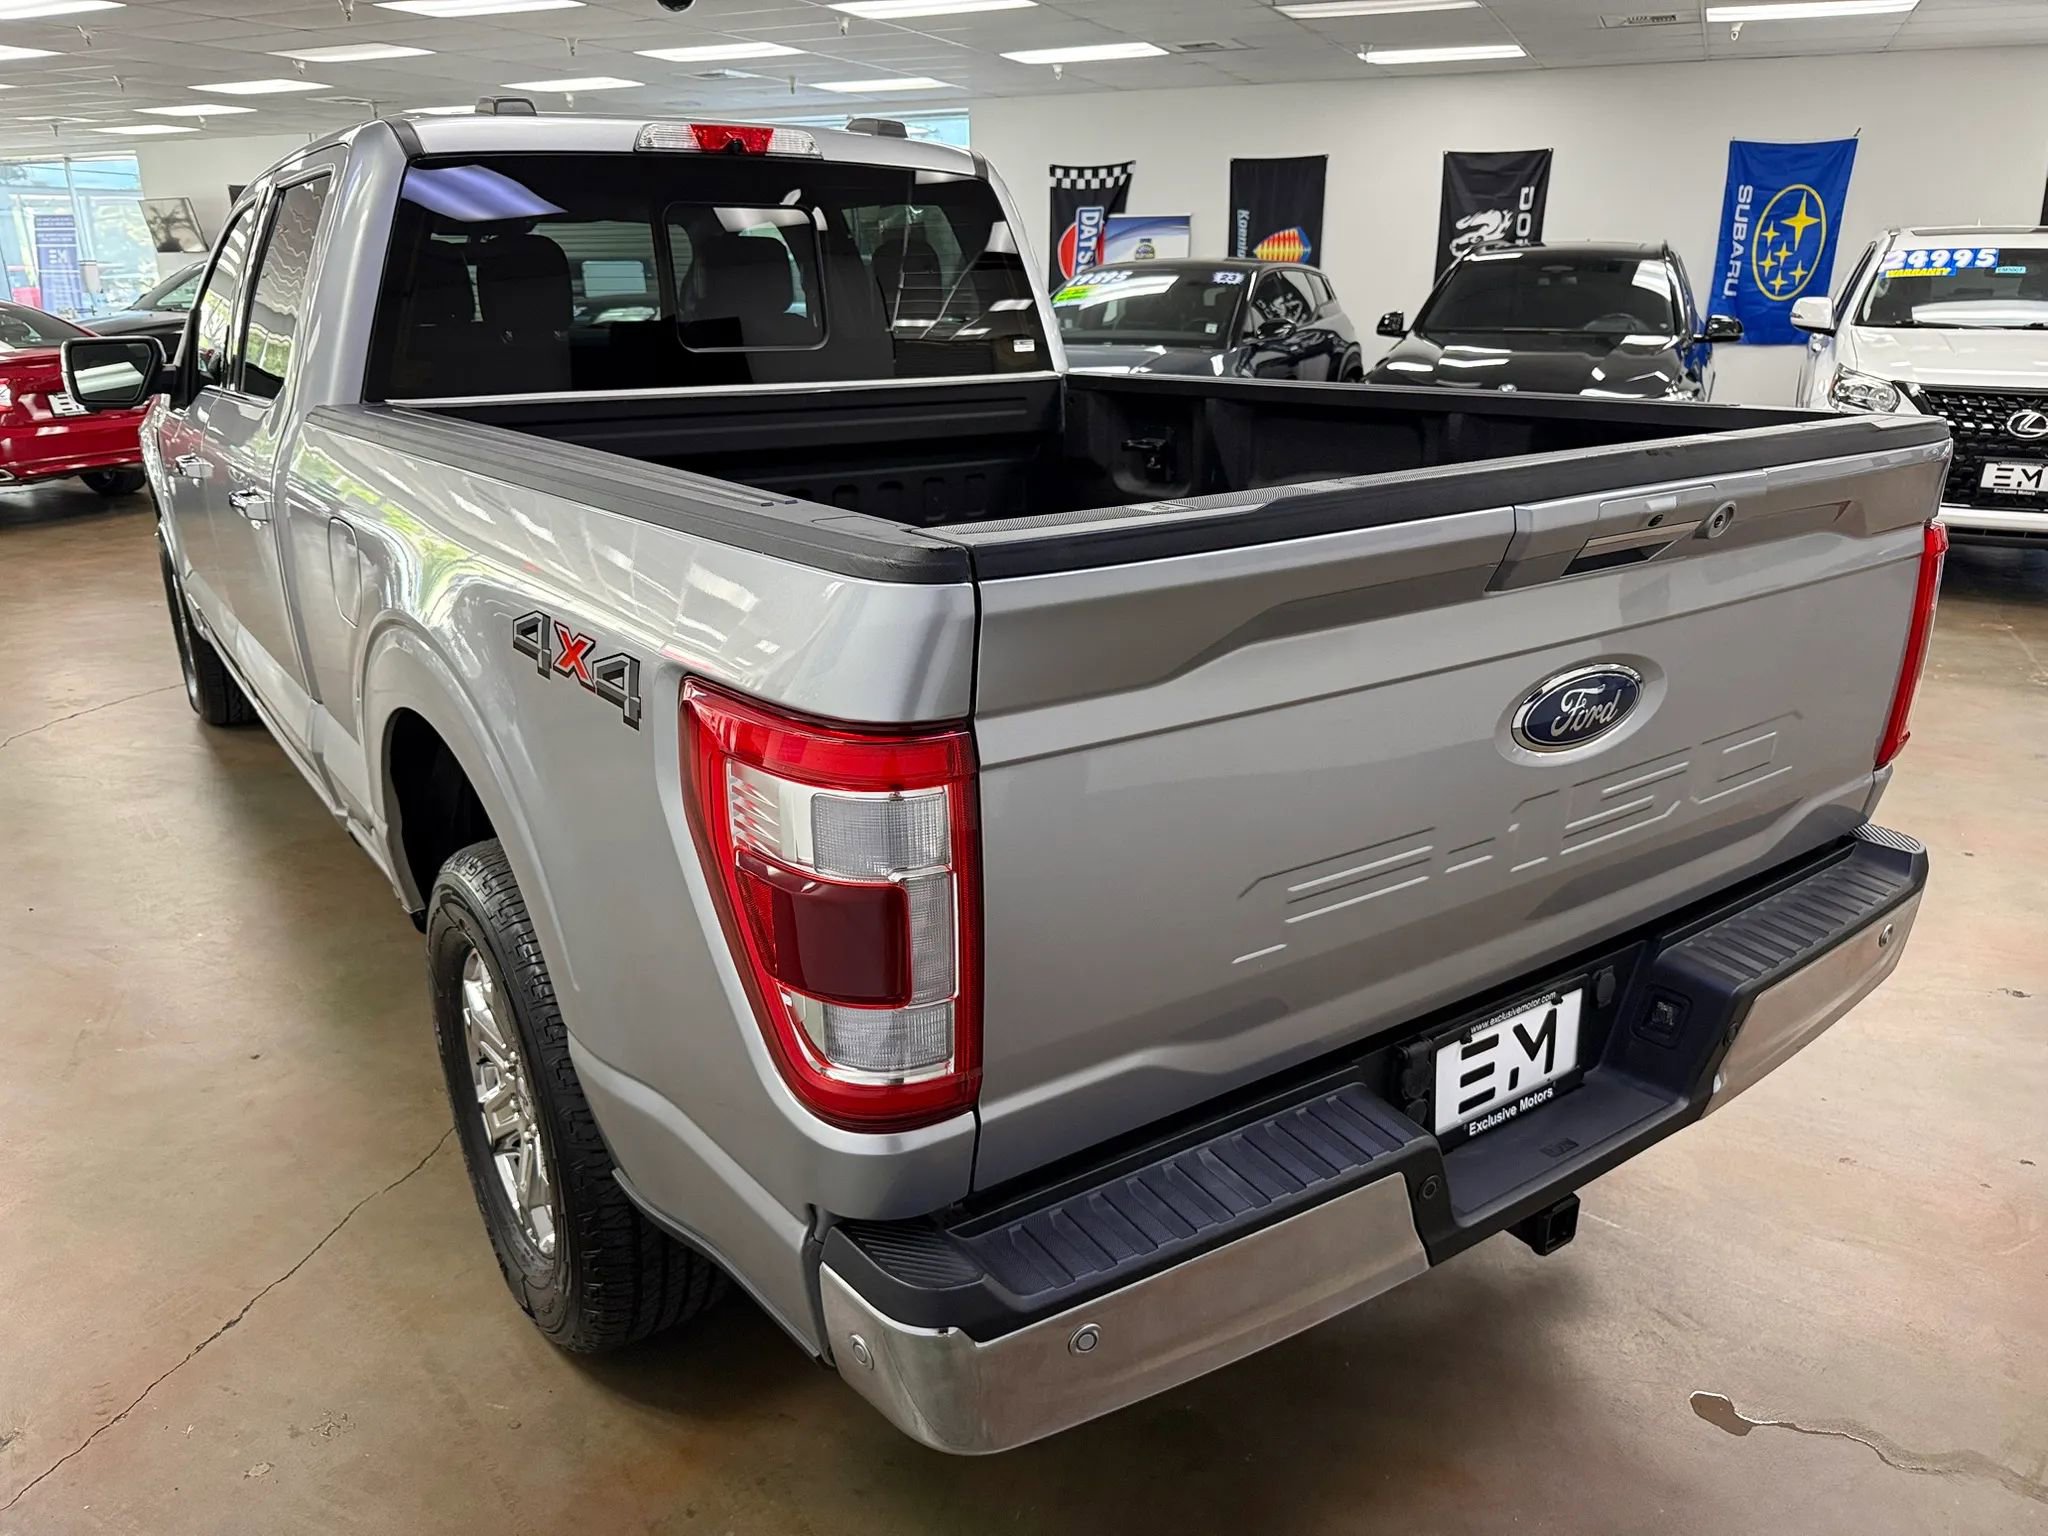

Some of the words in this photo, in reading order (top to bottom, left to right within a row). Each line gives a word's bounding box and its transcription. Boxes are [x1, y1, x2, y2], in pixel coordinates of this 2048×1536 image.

[1724, 184, 1754, 298] SUBARU
[1881, 248, 1997, 269] 24995
[1219, 274, 1238, 282] 23
[1993, 467, 2044, 489] EM
[1550, 683, 1622, 737] Ford
[1232, 711, 1803, 965] F-150
[1470, 991, 1556, 1034] www.exclusivemotor.com
[1458, 1007, 1558, 1115] EM
[1468, 1104, 1517, 1137] Exclusive
[1519, 1086, 1554, 1113] Motors
